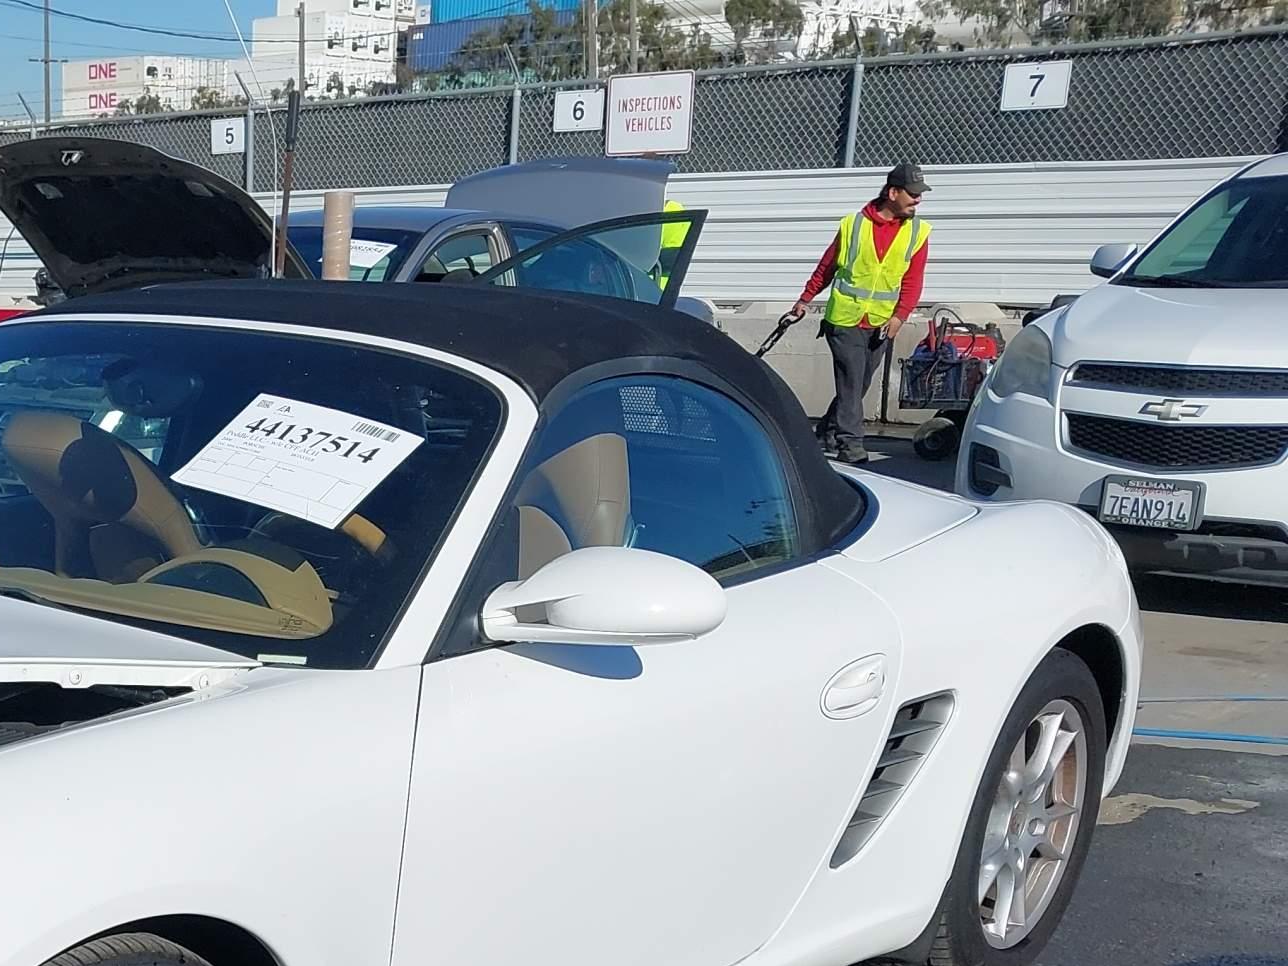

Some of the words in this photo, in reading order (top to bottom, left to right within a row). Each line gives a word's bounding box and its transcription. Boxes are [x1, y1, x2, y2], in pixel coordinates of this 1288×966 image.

[88, 62, 117, 80] ONE
[1029, 74, 1045, 97] 7
[88, 92, 117, 110] ONE
[618, 95, 682, 113] INSPECTIONS
[572, 100, 585, 121] 6
[625, 116, 672, 132] VEHICLES
[225, 127, 234, 145] 5
[245, 417, 381, 463] 44137514
[1128, 480, 1175, 490] SELMAN
[1109, 495, 1186, 521] 7EAN914
[1121, 517, 1169, 528] ORANGE
